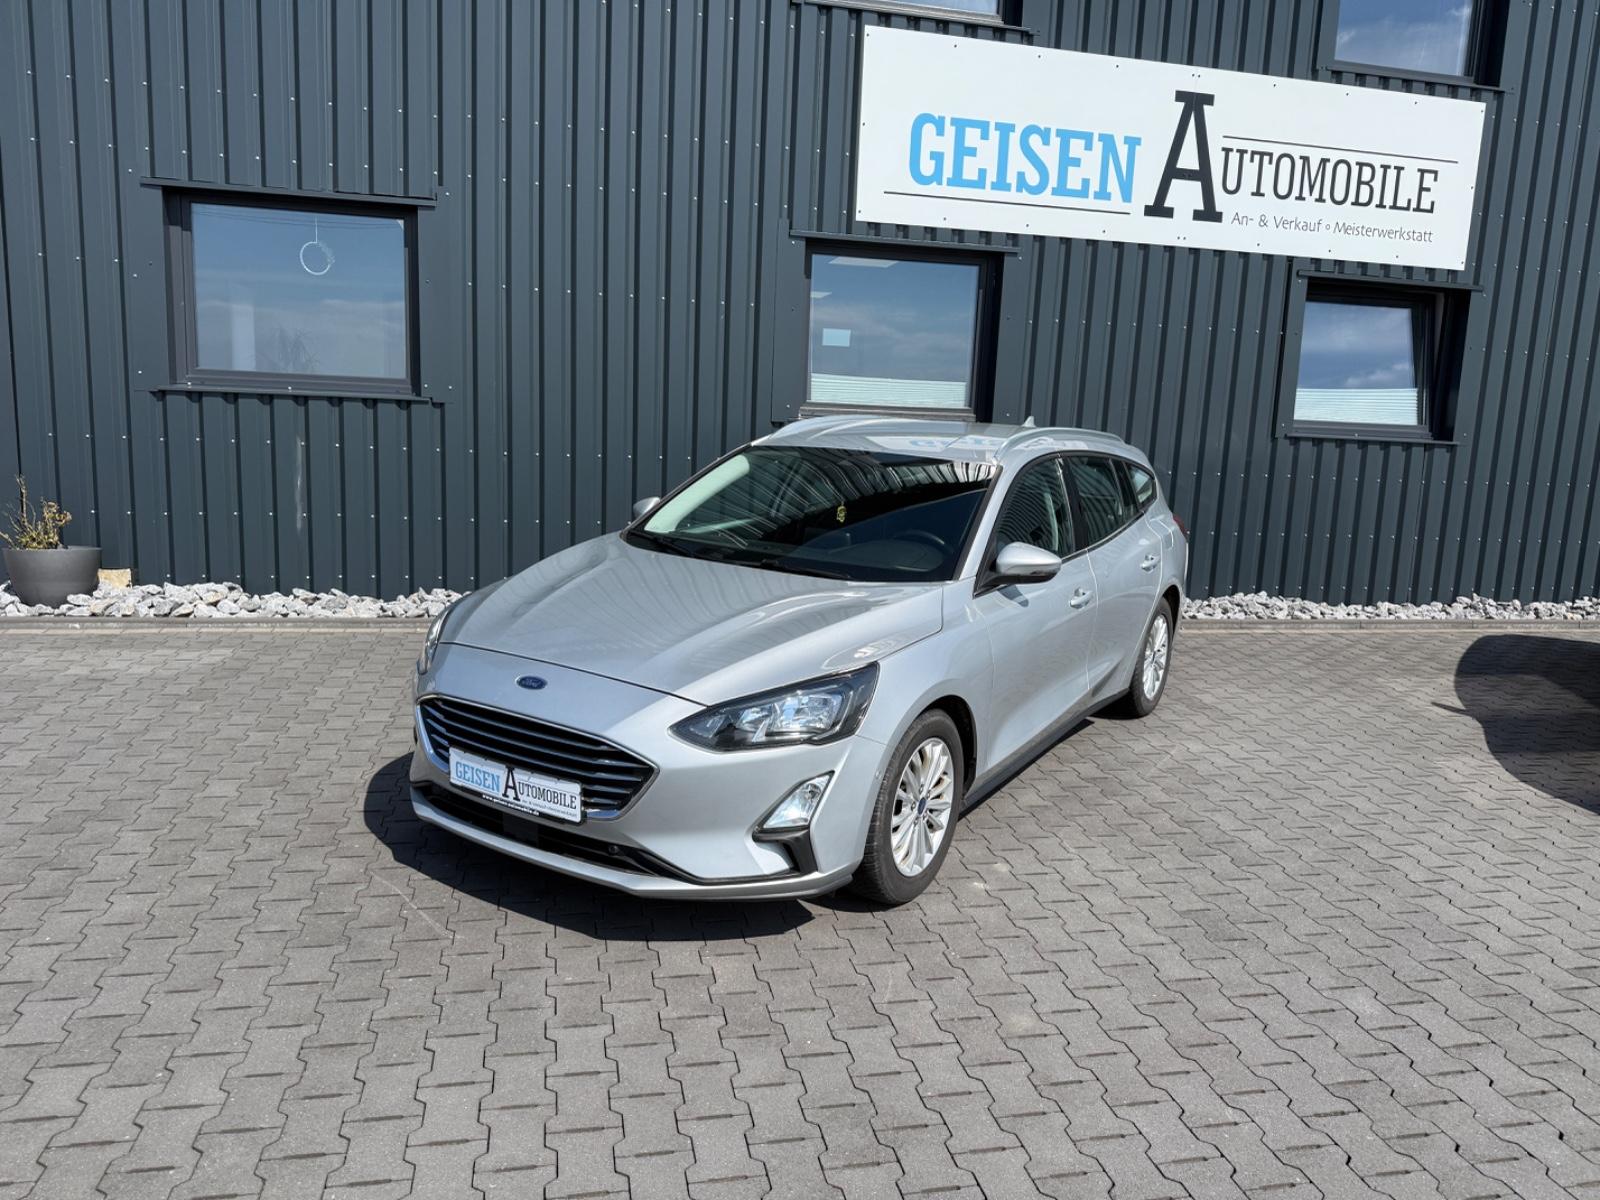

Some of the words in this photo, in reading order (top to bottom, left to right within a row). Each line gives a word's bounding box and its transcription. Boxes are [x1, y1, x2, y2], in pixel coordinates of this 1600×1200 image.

[909, 113, 1142, 203] GEISEN
[1144, 90, 1438, 223] AUTOMOBILE
[1231, 212, 1254, 226] An-
[1258, 214, 1268, 228] &
[1274, 215, 1322, 233] Verkauf
[1333, 222, 1433, 243] Meisterwerkstatt
[455, 761, 500, 792] GEISEN
[502, 766, 577, 809] AUTOMOBILE
